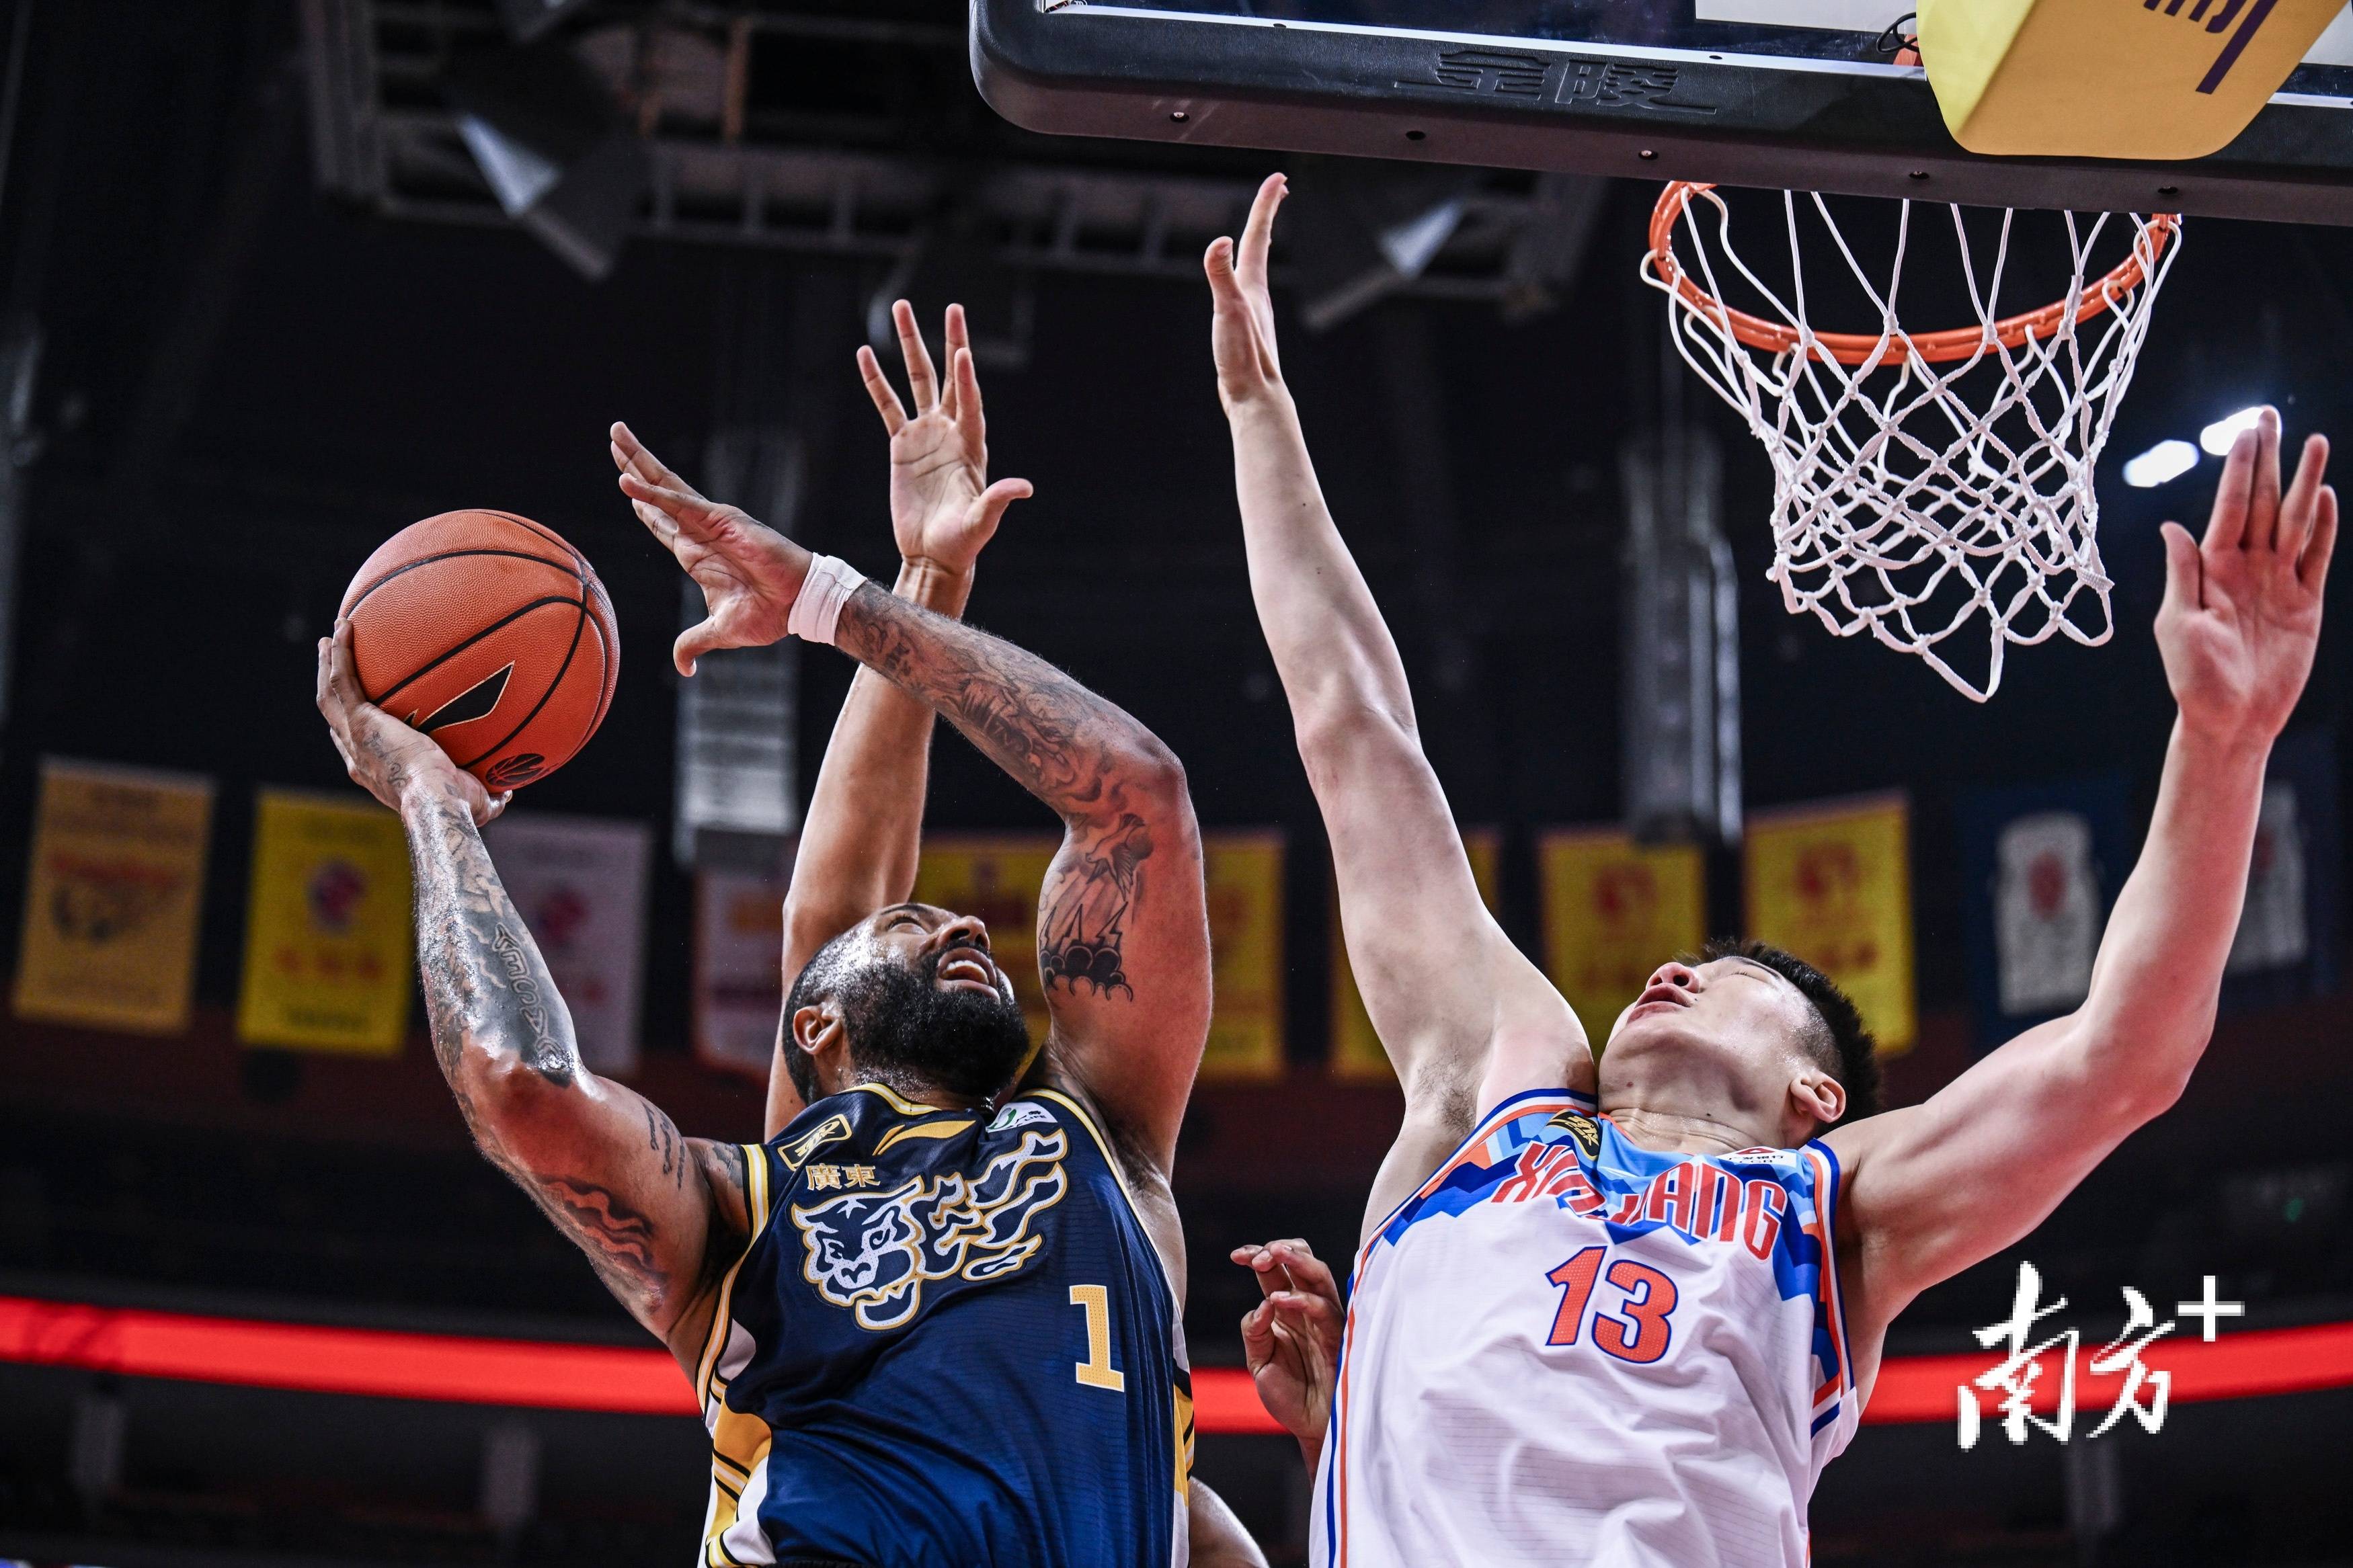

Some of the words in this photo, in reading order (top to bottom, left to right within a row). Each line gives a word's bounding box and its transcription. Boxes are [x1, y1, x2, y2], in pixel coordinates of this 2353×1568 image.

[1394, 50, 1717, 114] 金陵
[805, 1163, 881, 1190] 廣東
[1069, 1284, 1124, 1392] 1
[1545, 1245, 1679, 1364] 13
